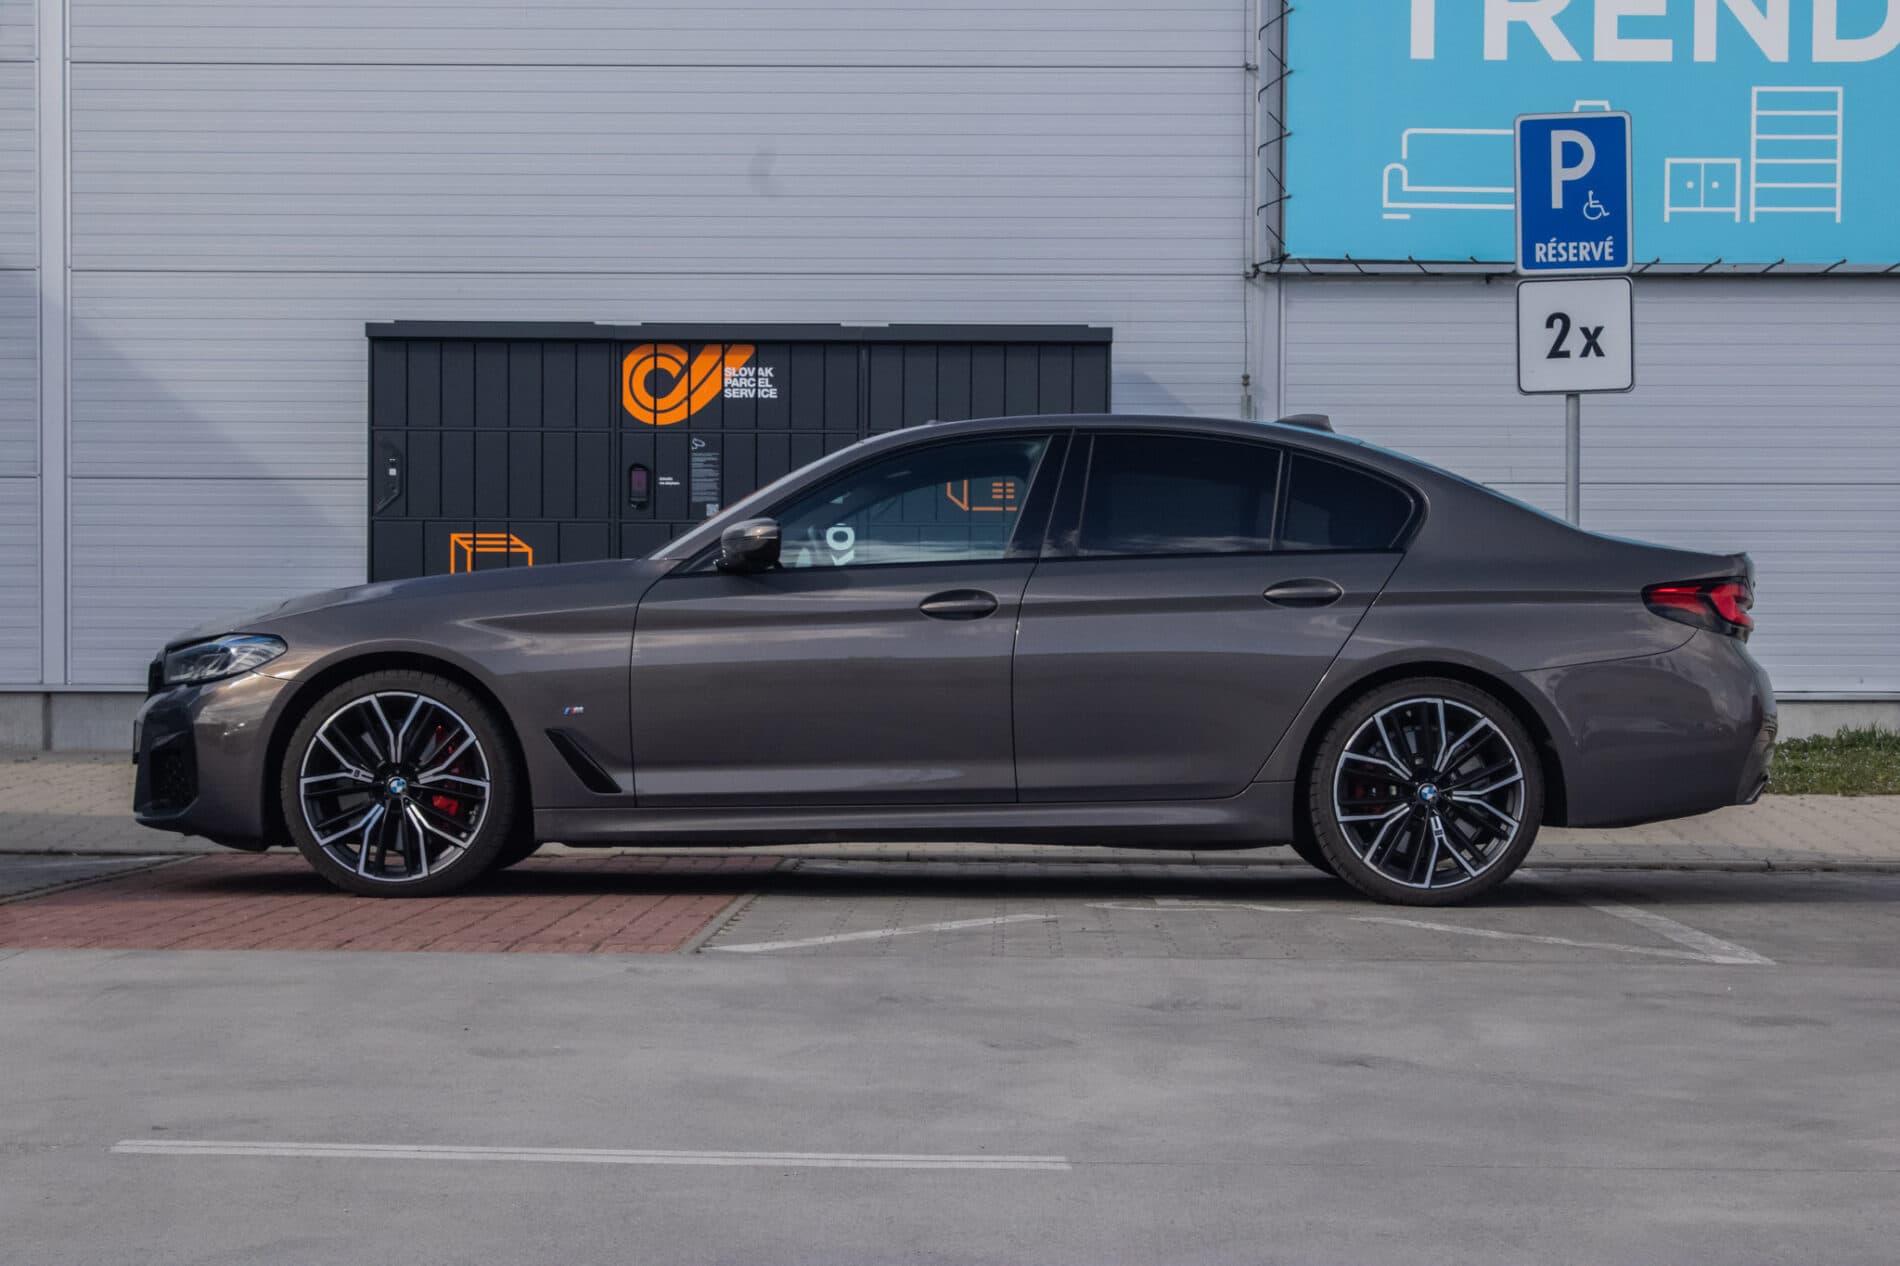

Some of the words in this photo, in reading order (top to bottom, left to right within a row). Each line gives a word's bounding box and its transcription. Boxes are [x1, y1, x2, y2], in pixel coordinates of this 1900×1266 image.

[1551, 130, 1596, 209] P
[1535, 236, 1614, 262] RÉSERVÉ
[724, 367, 774, 377] SLOVAK
[724, 377, 773, 387] PARCEL
[724, 388, 778, 398] SERVICE
